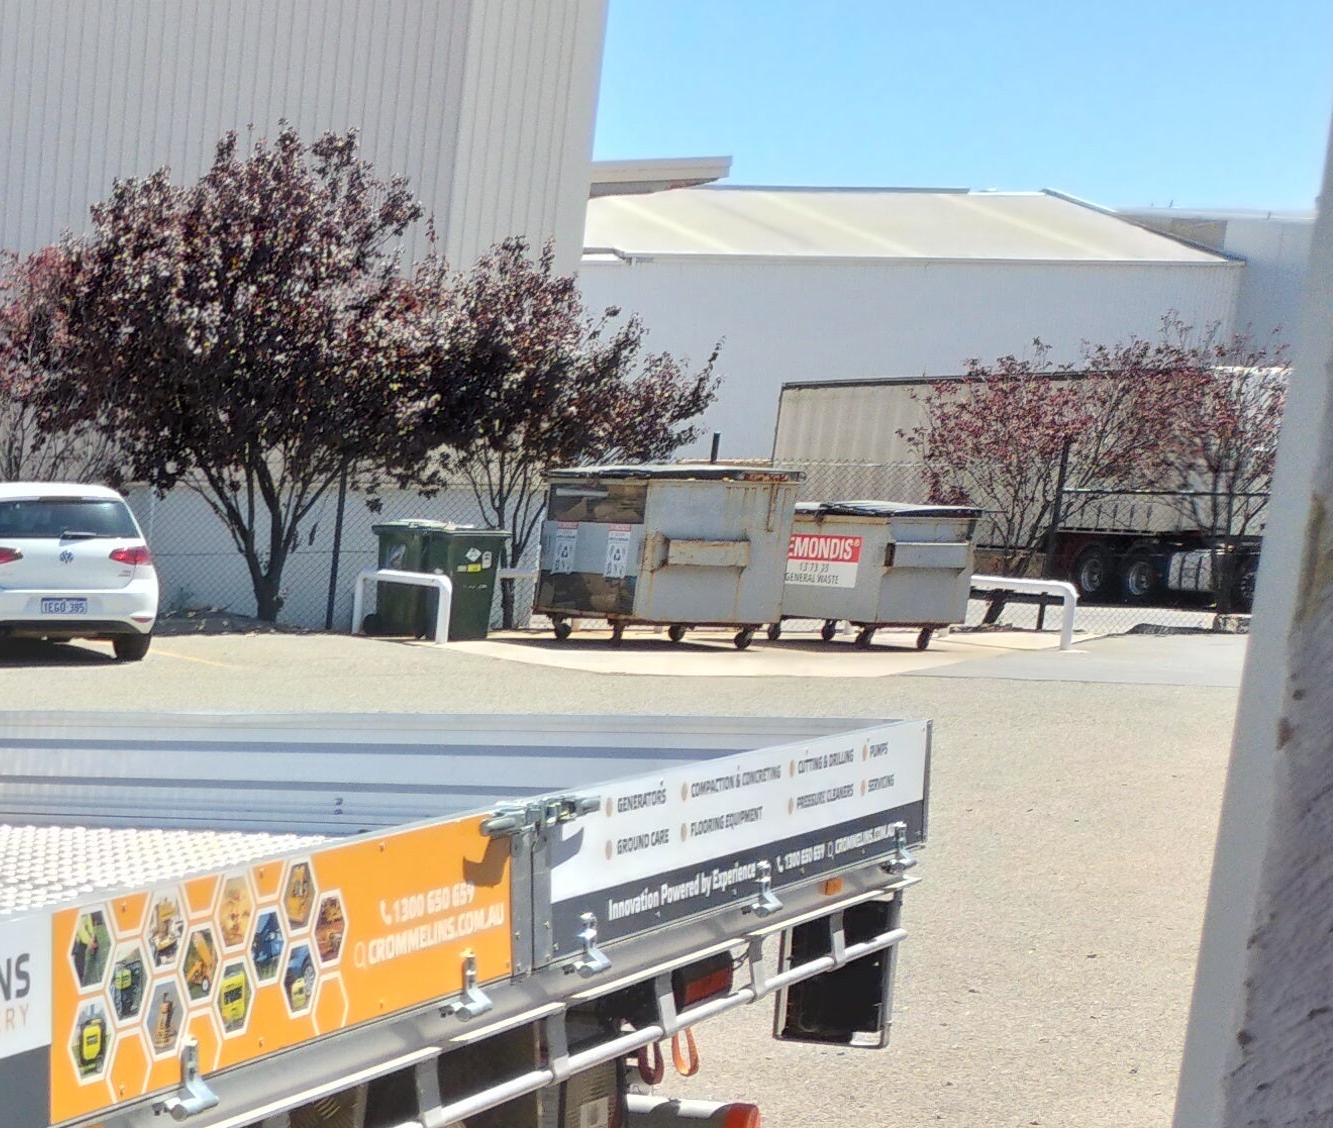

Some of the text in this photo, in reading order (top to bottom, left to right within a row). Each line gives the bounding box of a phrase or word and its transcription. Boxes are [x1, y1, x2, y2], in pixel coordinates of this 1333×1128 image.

[784, 572, 839, 585] GENERAL WASTE
[798, 755, 822, 774] CUTTING
[828, 748, 854, 767] DRILLING
[869, 742, 889, 758] PUMPS
[691, 775, 734, 798] COMPACTION
[742, 765, 781, 786] CONCRETING
[617, 788, 667, 813] GENERATORS
[690, 806, 763, 837] FLOORING EQUIPMENT
[617, 828, 670, 855] GROUND CARE
[393, 880, 476, 923] 1300 650 659
[608, 861, 757, 921] Innovation Powered by Experience
[368, 902, 505, 965] CROMMELINS.COM.AU
